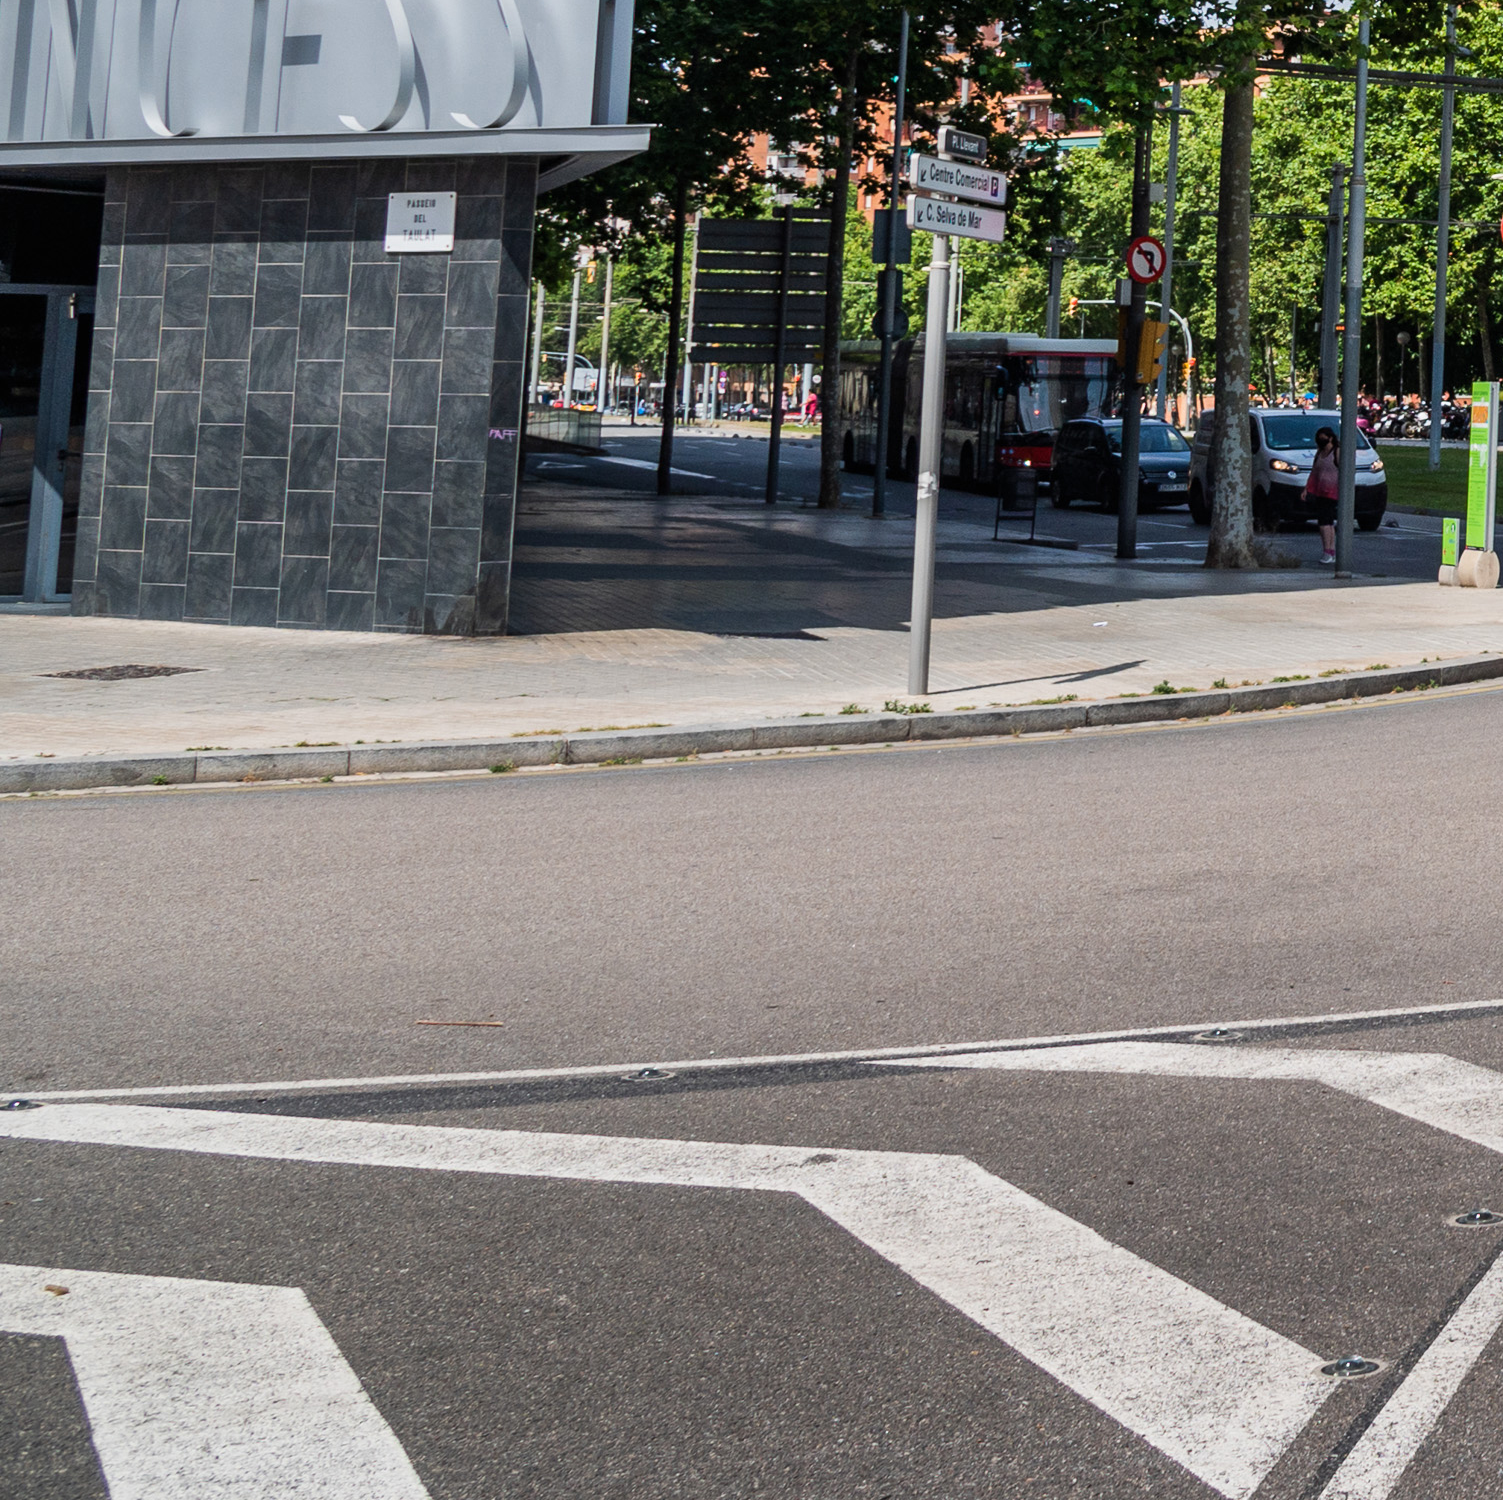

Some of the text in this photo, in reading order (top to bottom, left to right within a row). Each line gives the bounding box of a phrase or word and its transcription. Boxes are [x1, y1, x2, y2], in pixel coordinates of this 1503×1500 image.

[960, 137, 979, 153] Llevant
[930, 163, 954, 184] Centre
[955, 168, 990, 192] Comercial
[413, 214, 426, 223] DEL
[926, 203, 982, 229] C. Selva de Mar
[403, 229, 436, 241] TAULAT
